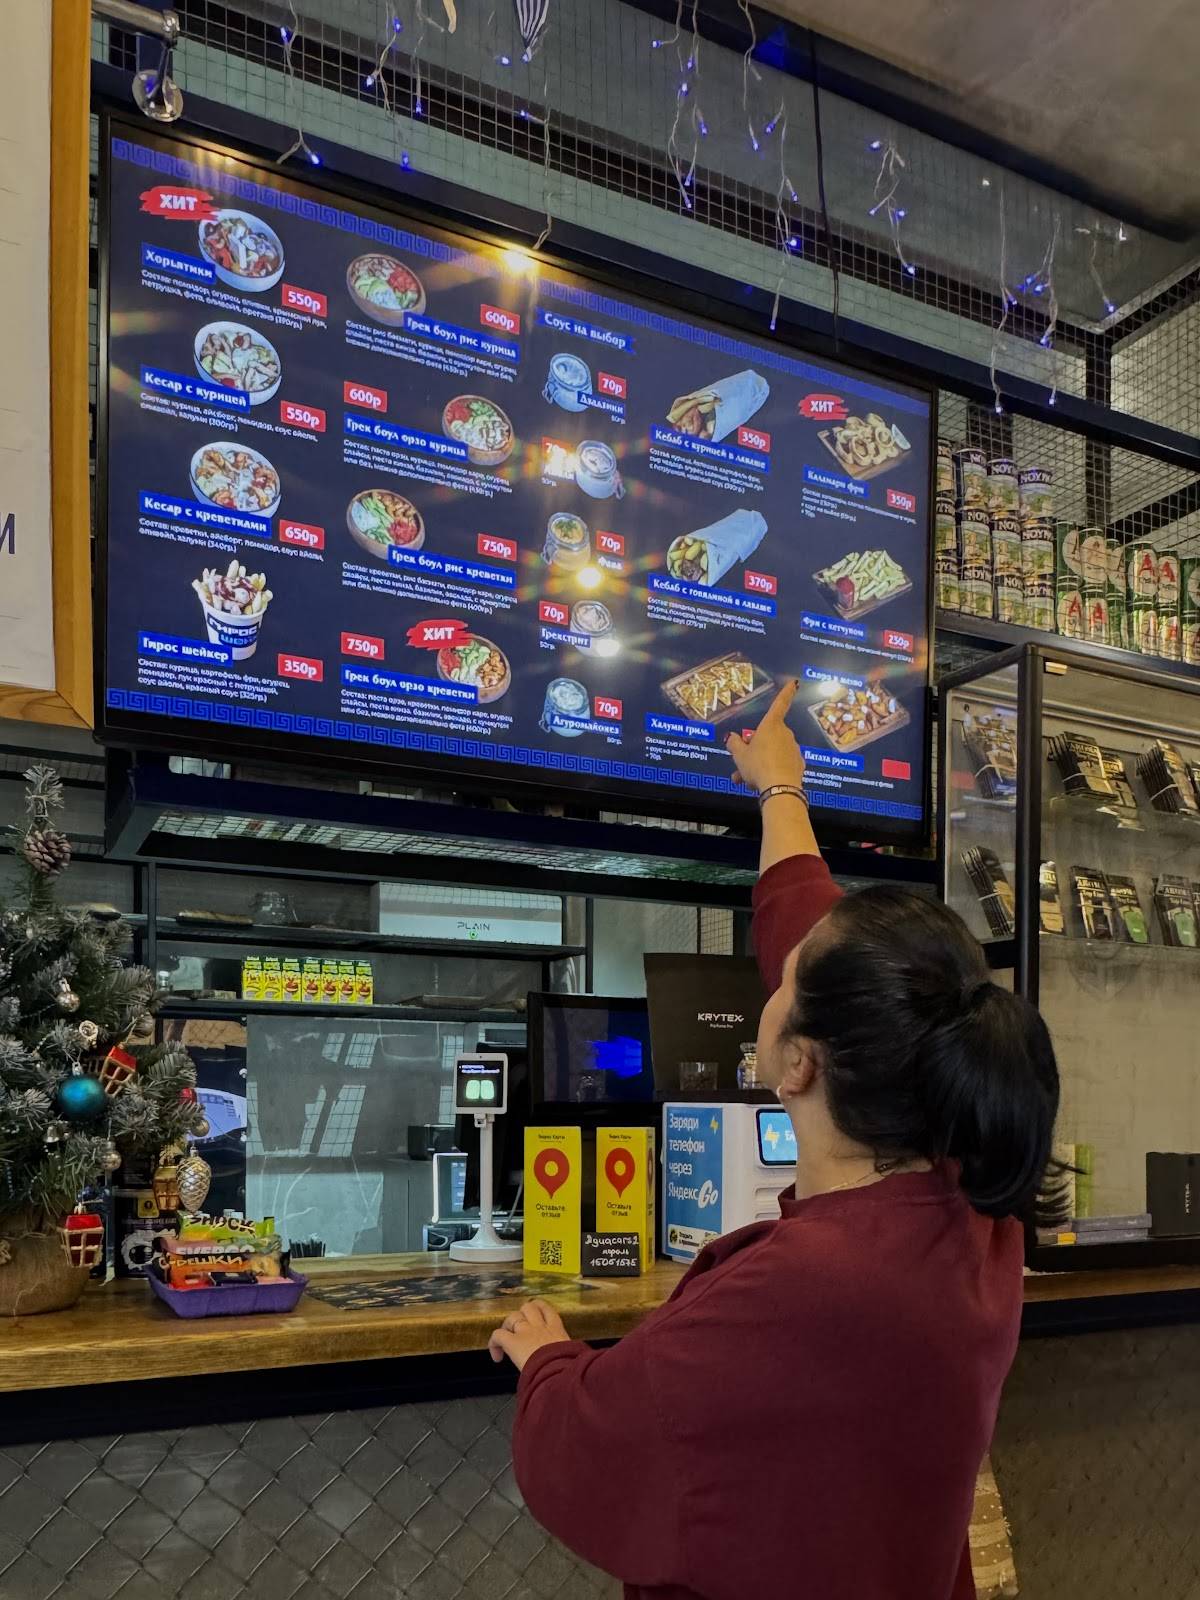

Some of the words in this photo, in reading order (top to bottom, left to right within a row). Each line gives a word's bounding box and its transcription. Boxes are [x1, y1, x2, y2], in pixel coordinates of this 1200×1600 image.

[160, 193, 198, 211] ХИТ
[145, 250, 213, 278] Хорьятики
[288, 291, 321, 313] 550р
[485, 310, 514, 330] 600р
[408, 317, 430, 333] Грек
[433, 324, 457, 341] боул
[460, 332, 478, 346] рис
[481, 342, 516, 358] курица
[544, 313, 572, 331] Соус
[574, 324, 588, 336] на
[590, 330, 626, 349] выбор
[144, 372, 182, 393] Кесар
[186, 384, 193, 394] с
[196, 385, 246, 406] курицей
[602, 378, 623, 394] 70р
[350, 388, 382, 409] 600р
[810, 400, 835, 412] ХИТ
[287, 406, 320, 428] 550р
[346, 418, 372, 434] Грек
[374, 424, 400, 441] боул
[402, 434, 426, 447] орзо
[429, 441, 466, 457] курица
[655, 430, 682, 446] Кебаб
[684, 440, 690, 448] с
[692, 442, 727, 458] курицей
[742, 431, 766, 450] 350р
[892, 494, 912, 510] 350р
[144, 496, 182, 516] Кесар
[186, 508, 192, 517] с
[196, 510, 267, 532] креветками
[285, 526, 318, 547] 650р
[600, 536, 620, 552] 70р
[482, 540, 512, 558] 750р
[392, 550, 416, 564] Грек
[418, 555, 442, 570] боул
[445, 563, 464, 575] рис
[466, 567, 513, 584] креветки
[748, 576, 772, 592] 370р
[653, 578, 680, 592] Кебаб
[689, 588, 733, 604] говядиной
[742, 601, 772, 613] лаваше
[544, 606, 564, 622] 70р
[423, 626, 455, 641] ХИТ
[802, 616, 820, 628] Фри
[828, 623, 864, 637] кетчупом
[143, 637, 178, 653] Гирос
[182, 646, 229, 663] шейкер
[347, 638, 379, 657] 750р
[284, 660, 318, 678] 350р
[344, 670, 370, 683] Грек
[372, 674, 397, 688] боул
[400, 680, 424, 692] орзо
[428, 684, 475, 700] креветки
[598, 701, 618, 716] 70р
[650, 718, 684, 733] Халуми
[686, 724, 710, 736] гриль
[804, 750, 831, 763] Патата
[832, 756, 858, 767] рустик
[457, 922, 490, 930] PLAIN
[698, 1012, 744, 1022] KRYTEX
[669, 1113, 699, 1133] Заряди
[669, 1139, 705, 1156] телефон
[669, 1163, 693, 1176] через
[668, 1184, 699, 1201] Яндекс
[698, 1180, 719, 1208] Go
[536, 1202, 565, 1211] Оставьте
[607, 1202, 632, 1210] Оставьте
